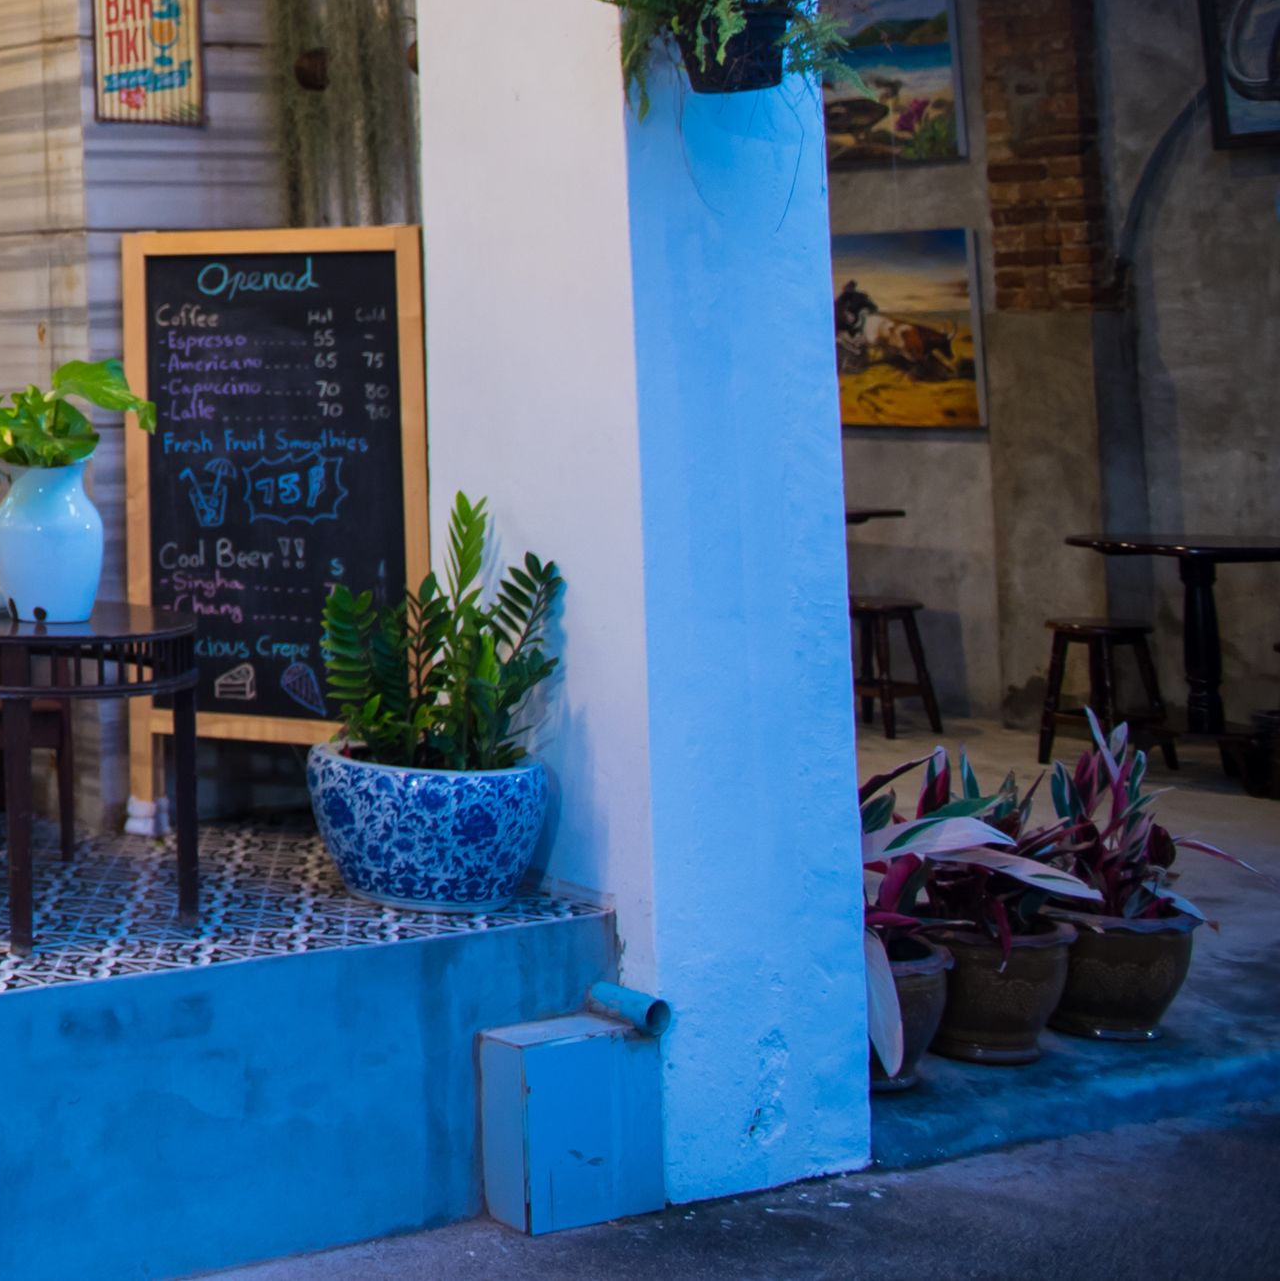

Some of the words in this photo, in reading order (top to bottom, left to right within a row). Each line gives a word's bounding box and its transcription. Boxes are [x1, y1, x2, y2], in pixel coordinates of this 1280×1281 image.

[105, 26, 146, 66] TIKI
[197, 256, 319, 301] Opened
[155, 304, 219, 328] Coffee
[313, 329, 336, 347] 55
[314, 351, 338, 369] 65
[362, 351, 385, 369] 75
[315, 380, 341, 399] 70
[317, 400, 343, 418] 70
[163, 432, 213, 454] Fresh
[224, 428, 266, 452] Fruit
[276, 428, 369, 453] Smoothies
[159, 539, 205, 569] Cool
[255, 635, 311, 664] Crepe
